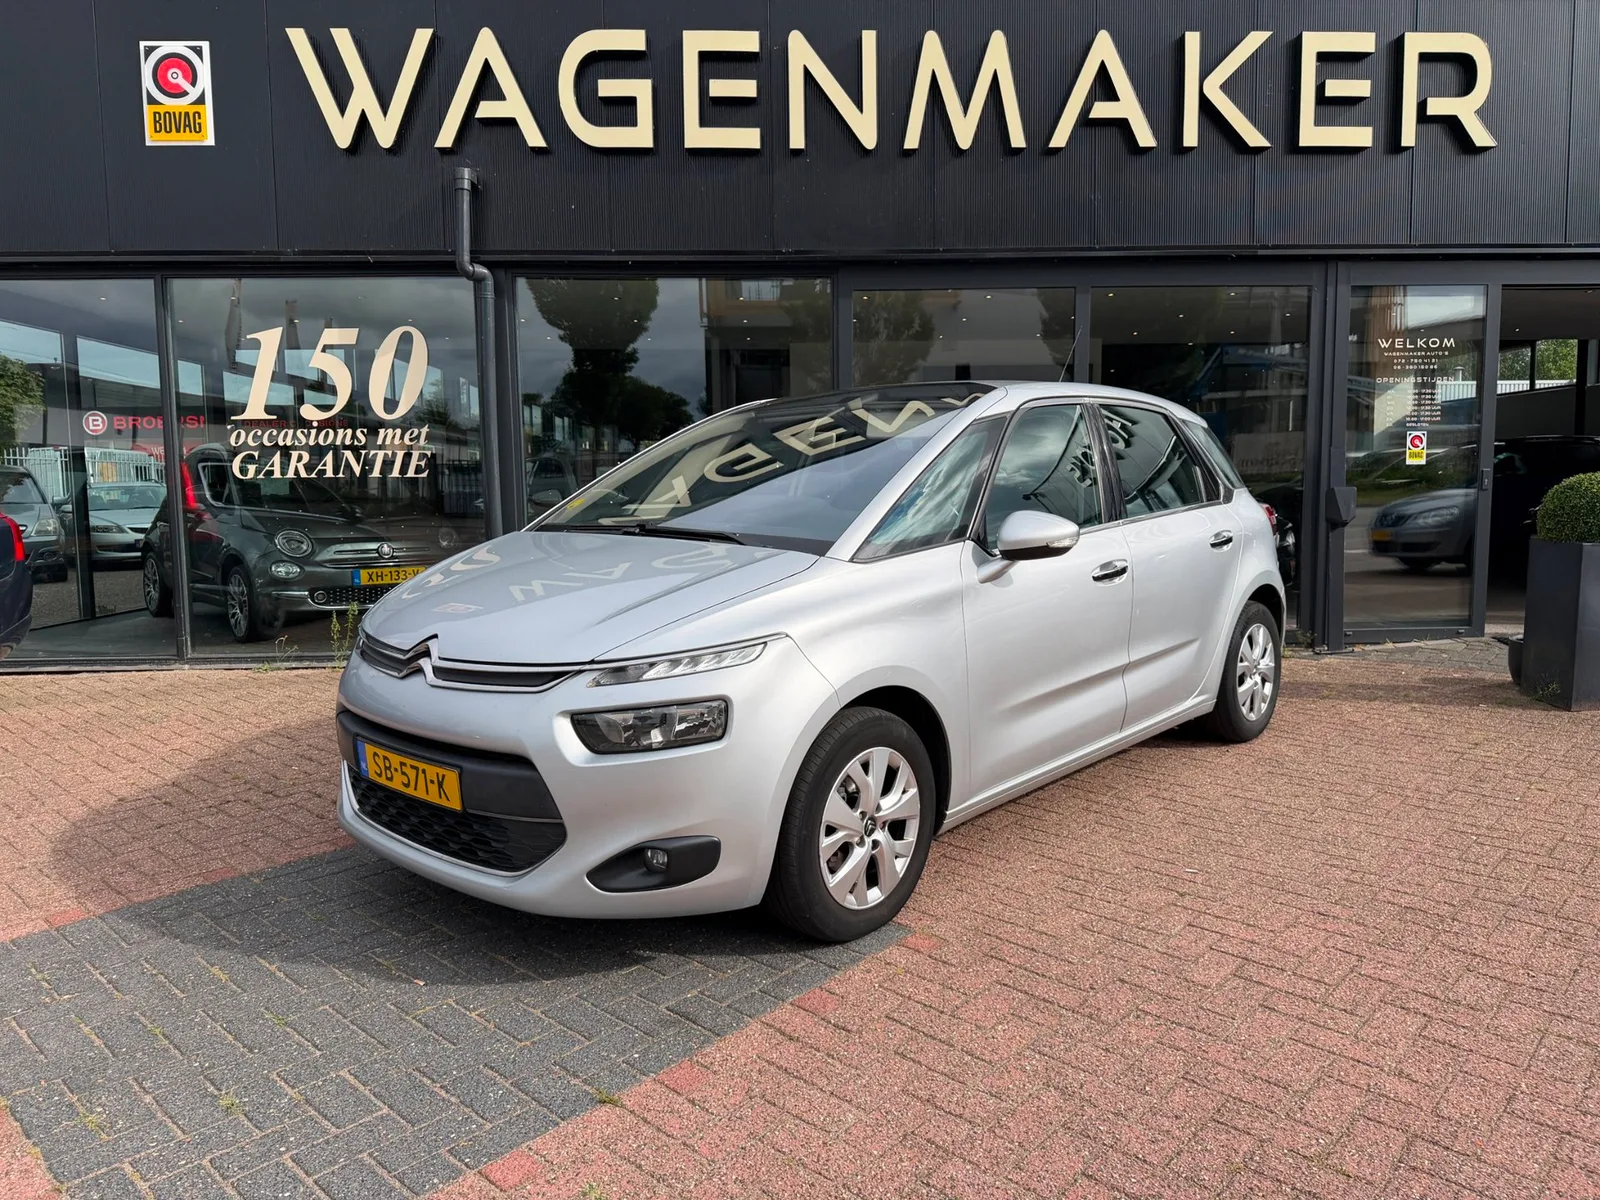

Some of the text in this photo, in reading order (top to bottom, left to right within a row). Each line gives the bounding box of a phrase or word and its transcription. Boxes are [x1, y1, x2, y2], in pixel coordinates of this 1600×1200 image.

[285, 27, 1497, 150] WAGENMAKER
[153, 111, 202, 133] BOVAG
[1377, 337, 1455, 348] WELKOM
[231, 325, 428, 420] 150
[229, 421, 429, 446] occasions met
[232, 449, 432, 479] GARANTIE
[372, 751, 450, 802] SB-571-K
